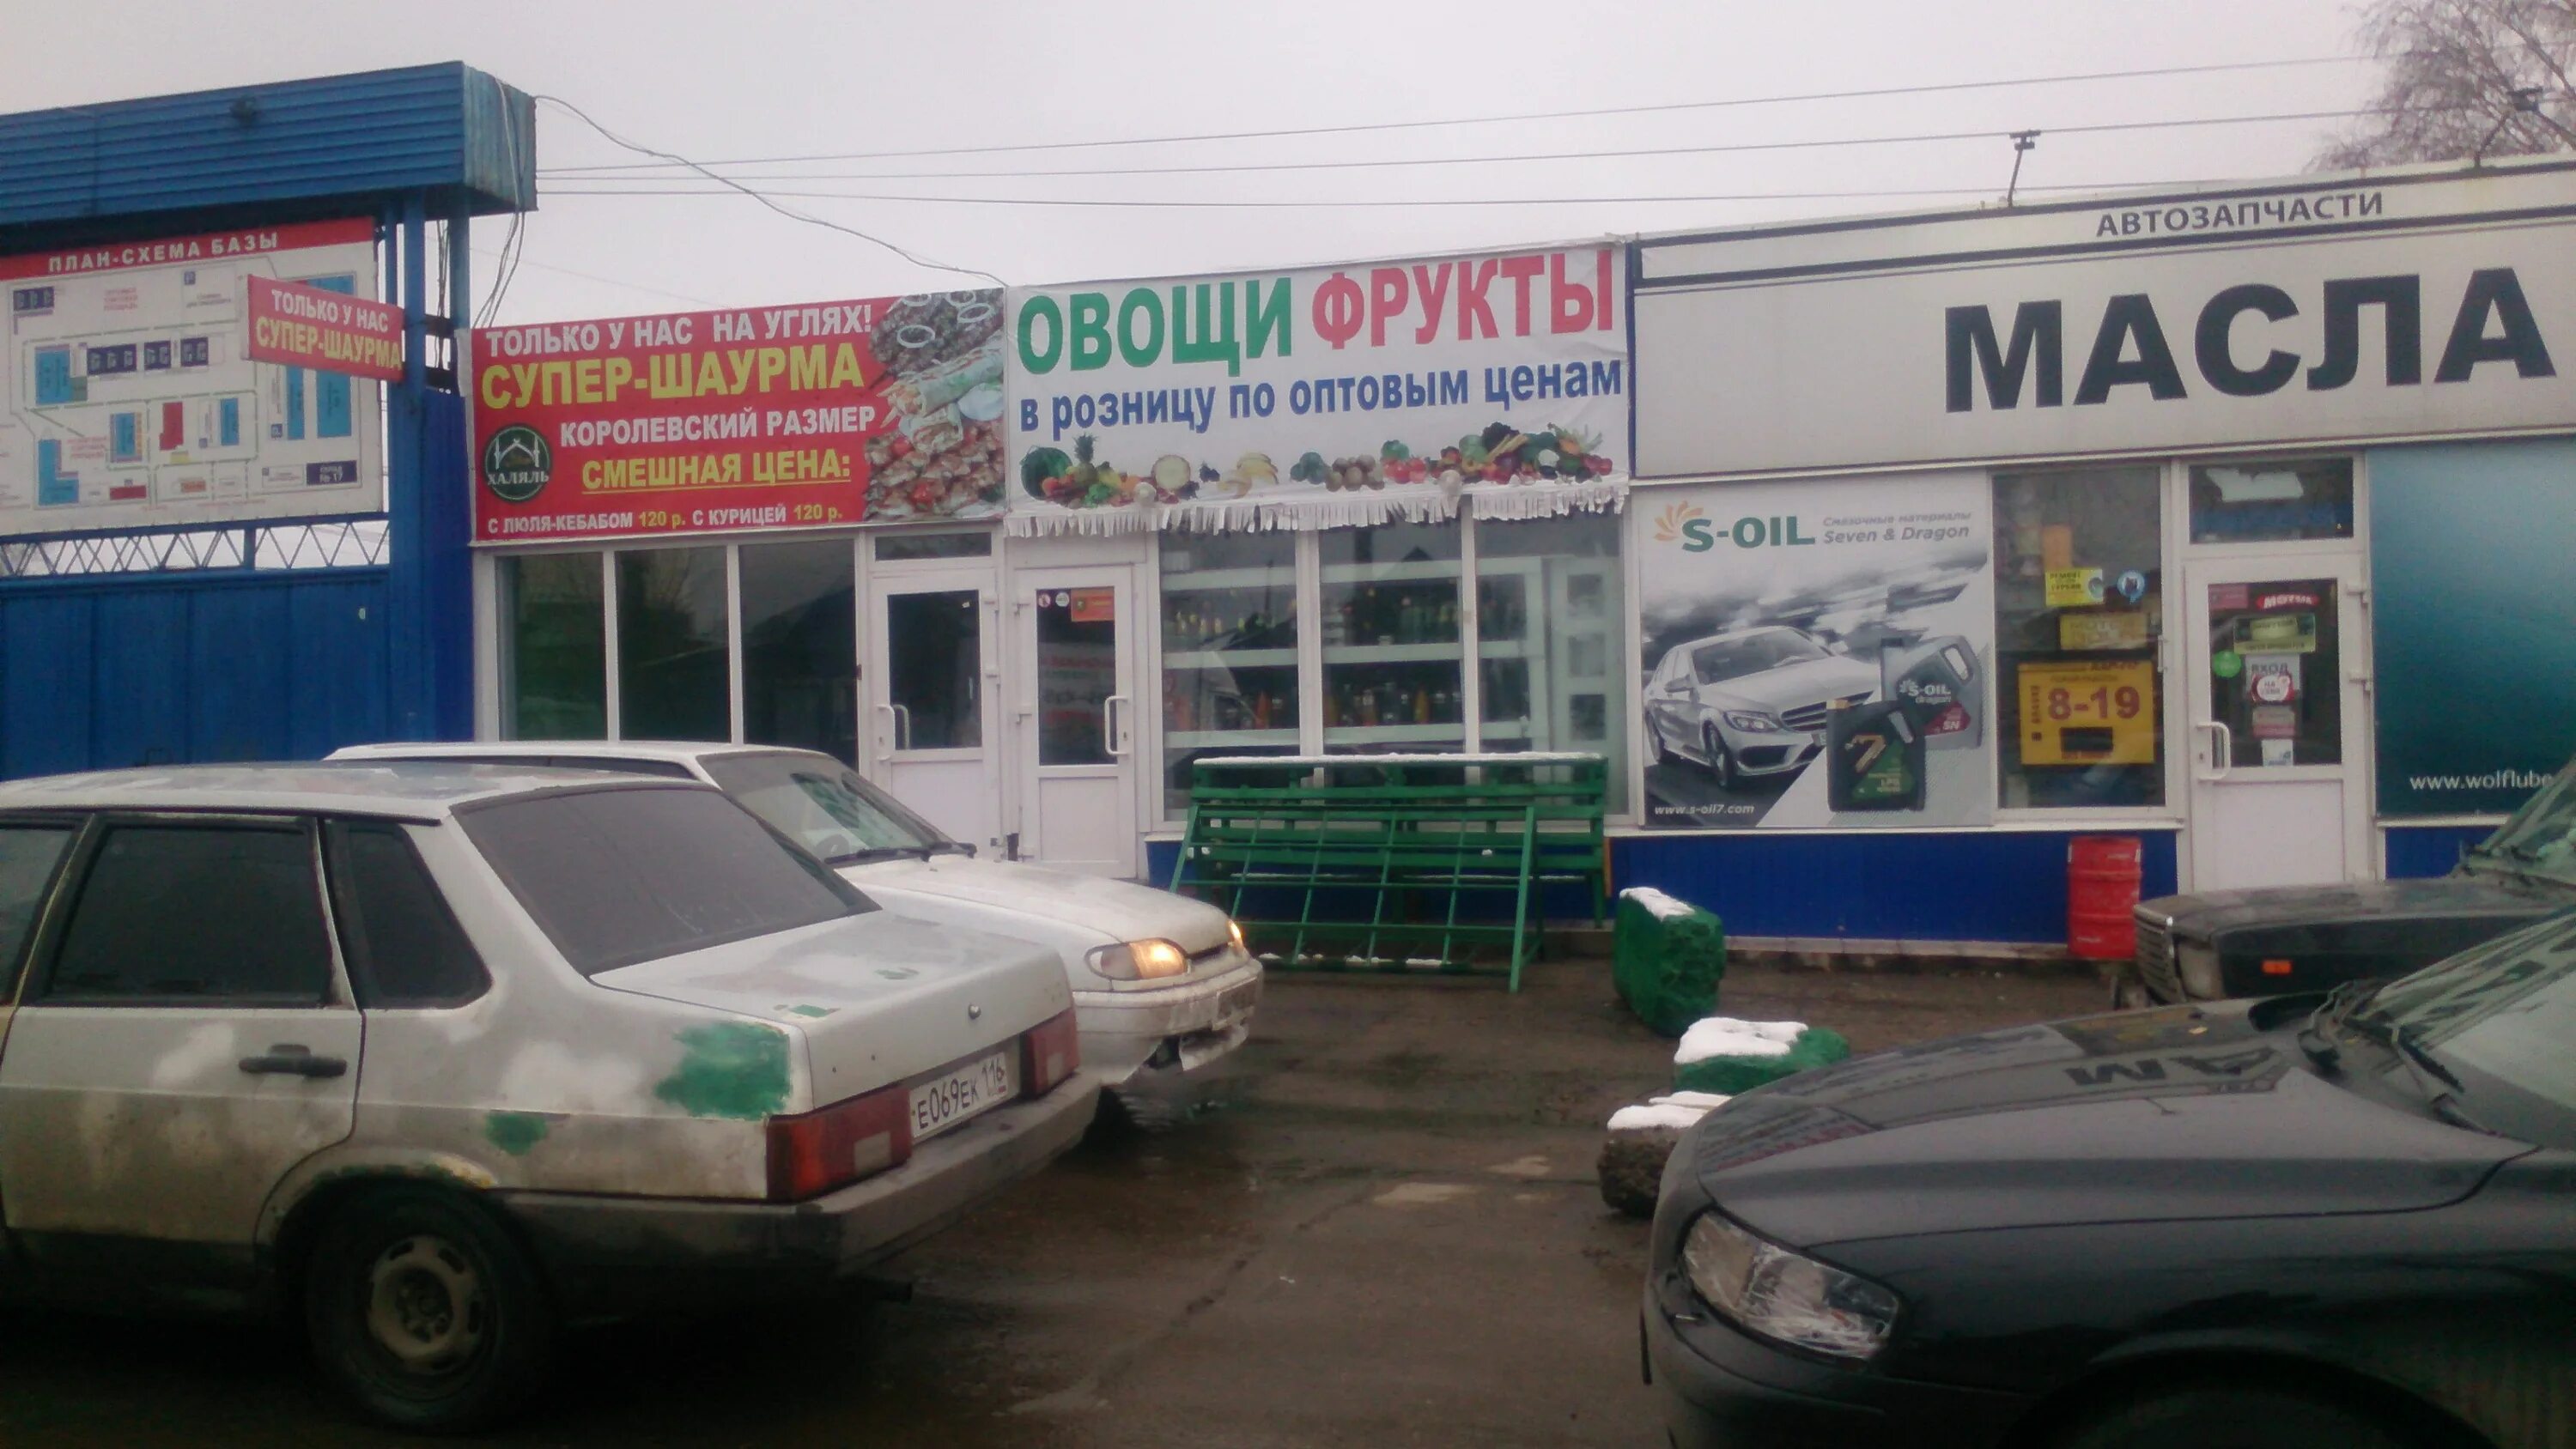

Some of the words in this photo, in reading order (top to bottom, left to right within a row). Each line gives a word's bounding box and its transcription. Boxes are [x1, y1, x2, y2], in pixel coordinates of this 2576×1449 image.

[2096, 191, 2383, 238] АВТОЗАПЧАСТИ
[48, 242, 201, 273] ПЛАН-СХЕМА
[211, 233, 278, 255] БАЗЫ
[271, 288, 338, 324] ТОЛЬКО
[343, 306, 354, 327] У
[356, 310, 389, 333] НАС
[486, 324, 599, 358] ТОЛЬКО
[608, 321, 631, 351] У
[635, 317, 693, 348] НАС
[714, 312, 756, 342] НА
[764, 304, 872, 339] УГЛЯХ!
[1018, 276, 1292, 377] ОВОЩИ
[1312, 250, 1613, 349] ФРУКТЫ
[256, 316, 403, 371] СУПЕР-ШАУРМА
[1945, 266, 2557, 414] МАСЛА
[481, 343, 865, 409] СУПЕР-ШАУРМА
[1021, 397, 1038, 433] в
[1052, 385, 1217, 440] розницу
[1230, 381, 1275, 419] по
[1289, 368, 1468, 415] оптовым
[1484, 359, 1621, 410] ценам
[560, 407, 757, 448] КОРОЛЕВСКИЙ
[767, 406, 876, 436] РАЗМЕР
[487, 470, 550, 486] ХАЛЯЛЬ
[582, 452, 743, 490] СМЕШНАЯ
[753, 447, 852, 484] ЦЕНА:
[488, 518, 497, 533] С
[501, 512, 634, 532] ЛЮЛЯ-КЕБАБОМ
[639, 511, 667, 527] 120
[671, 514, 685, 530] р.
[692, 510, 704, 526] С
[707, 504, 787, 527] КУРИЦЕЙ
[794, 506, 823, 521] 120
[828, 507, 842, 525] р.
[1682, 515, 1816, 552] S-OIL
[1824, 530, 1877, 544] Seven
[1883, 527, 1895, 542] &
[1901, 525, 1970, 542] Dragon
[1908, 684, 1952, 697] S-OIL
[2047, 686, 2141, 720] 8-19
[1655, 803, 1754, 815] www.s-oil7.com
